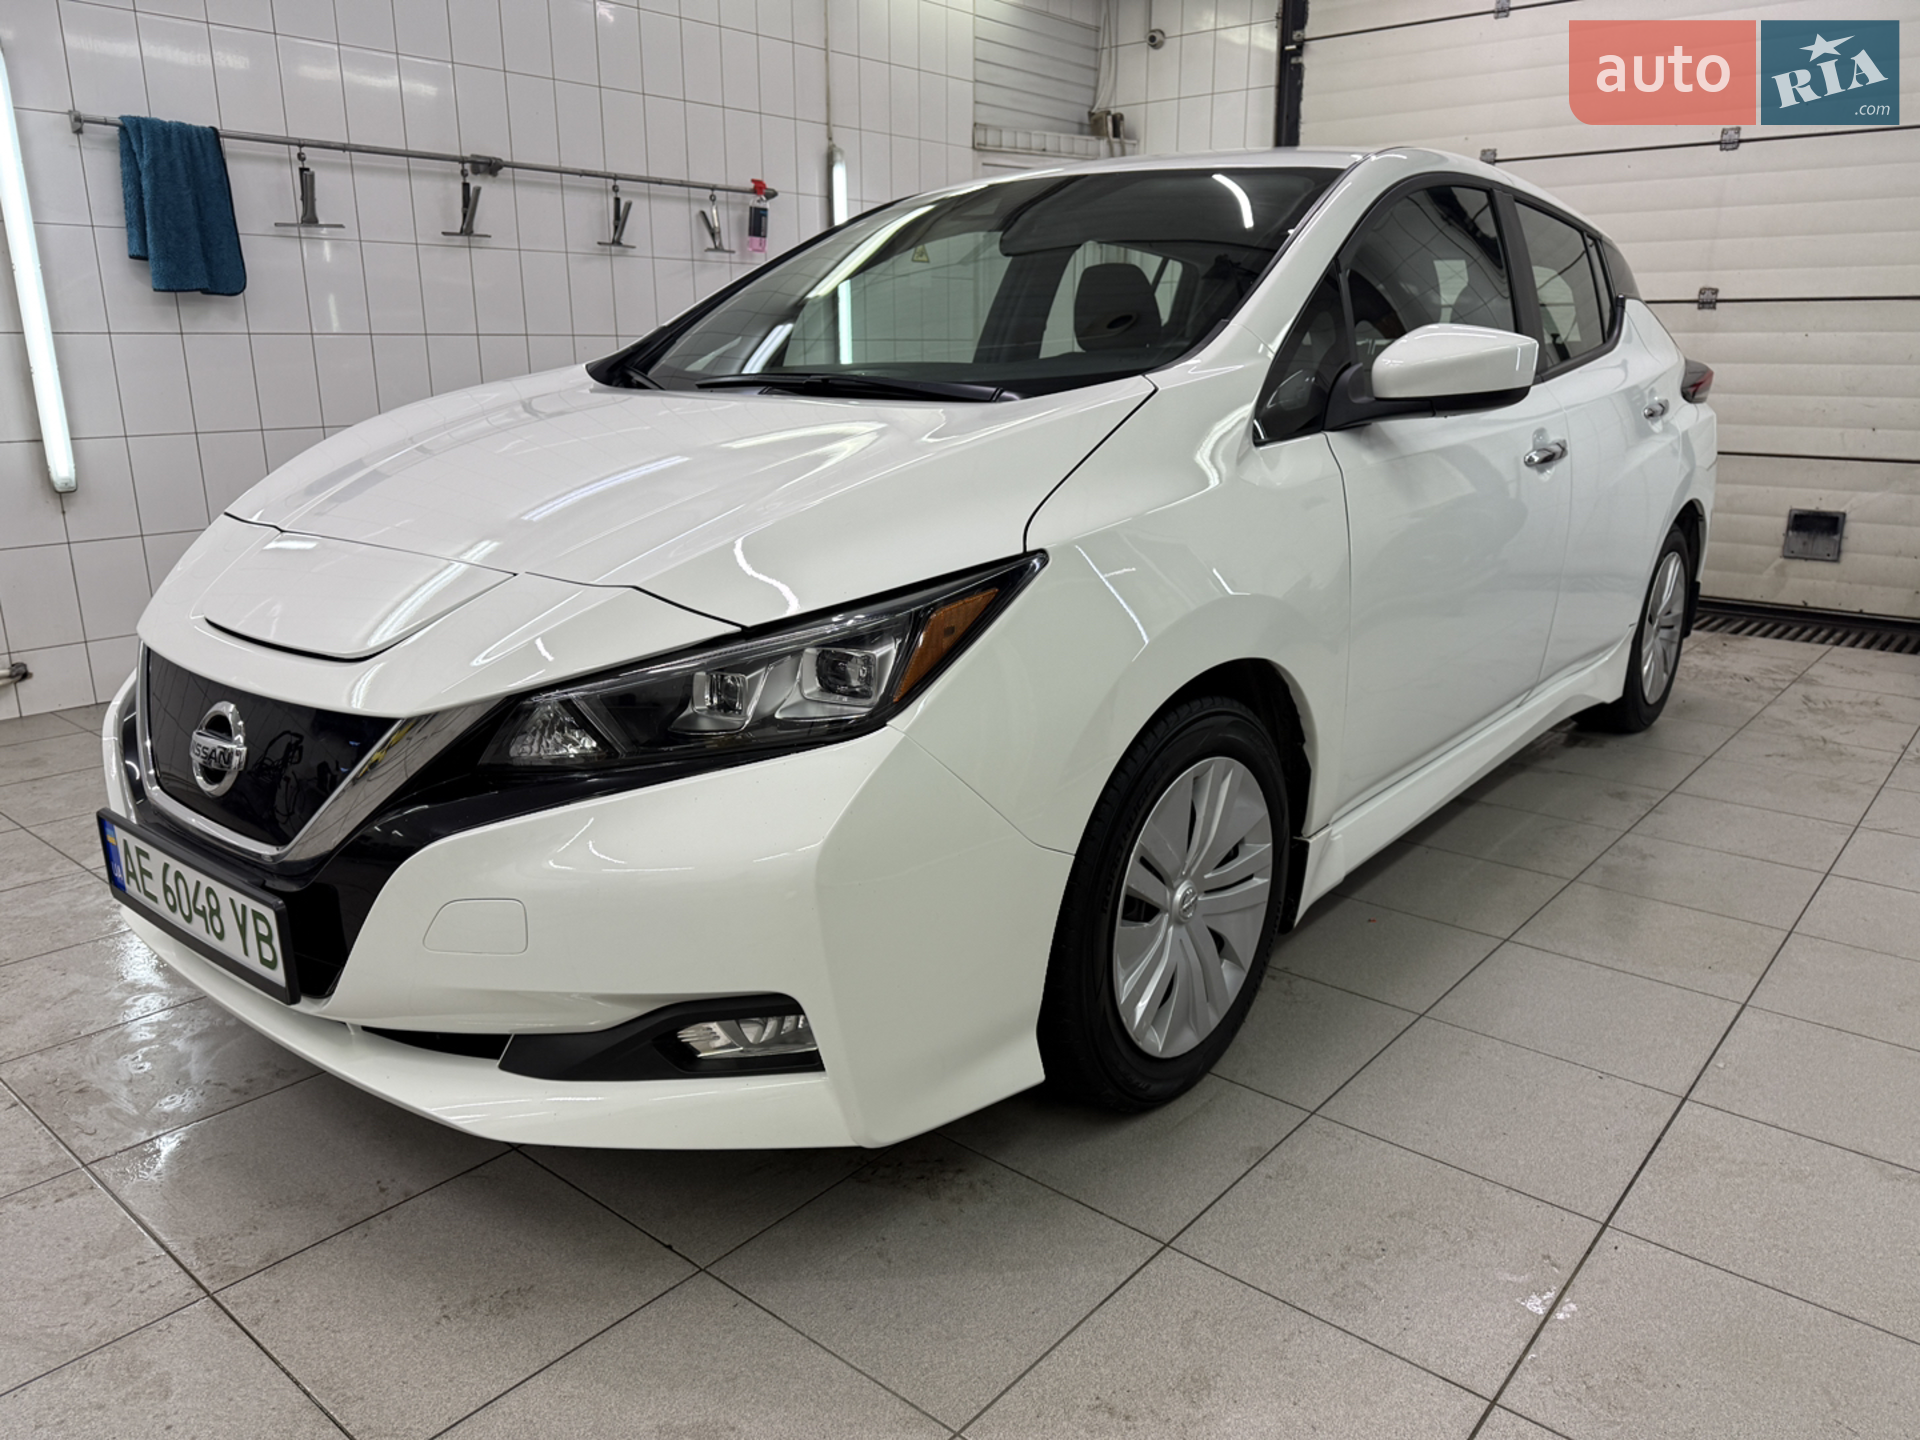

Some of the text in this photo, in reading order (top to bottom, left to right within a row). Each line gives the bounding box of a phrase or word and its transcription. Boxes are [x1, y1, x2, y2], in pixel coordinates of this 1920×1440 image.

[193, 741, 233, 766] SSAN
[111, 862, 124, 881] UA
[123, 838, 279, 972] AE 6048 YB
